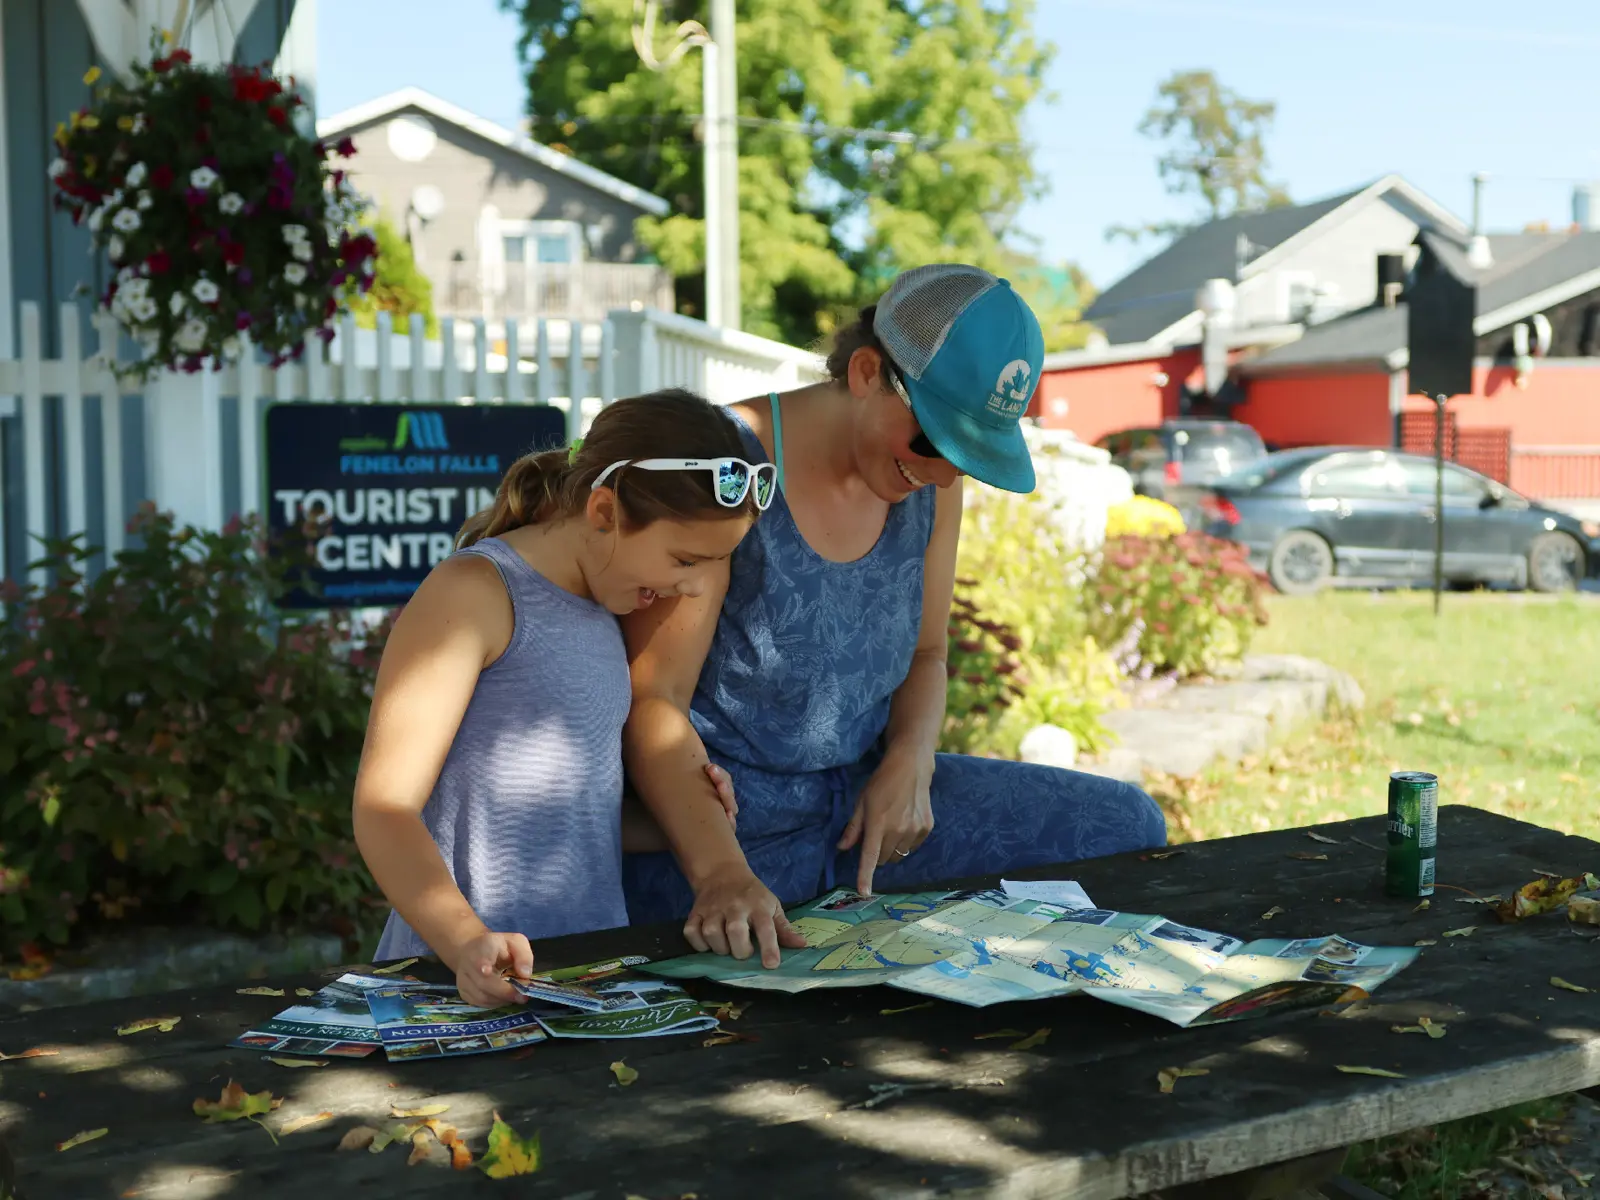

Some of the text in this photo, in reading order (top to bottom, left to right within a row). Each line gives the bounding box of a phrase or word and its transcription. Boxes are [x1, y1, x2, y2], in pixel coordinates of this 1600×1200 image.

[340, 455, 499, 473] FENELON FALLS
[275, 488, 498, 524] TOURIST IN
[316, 533, 462, 571] CENTR
